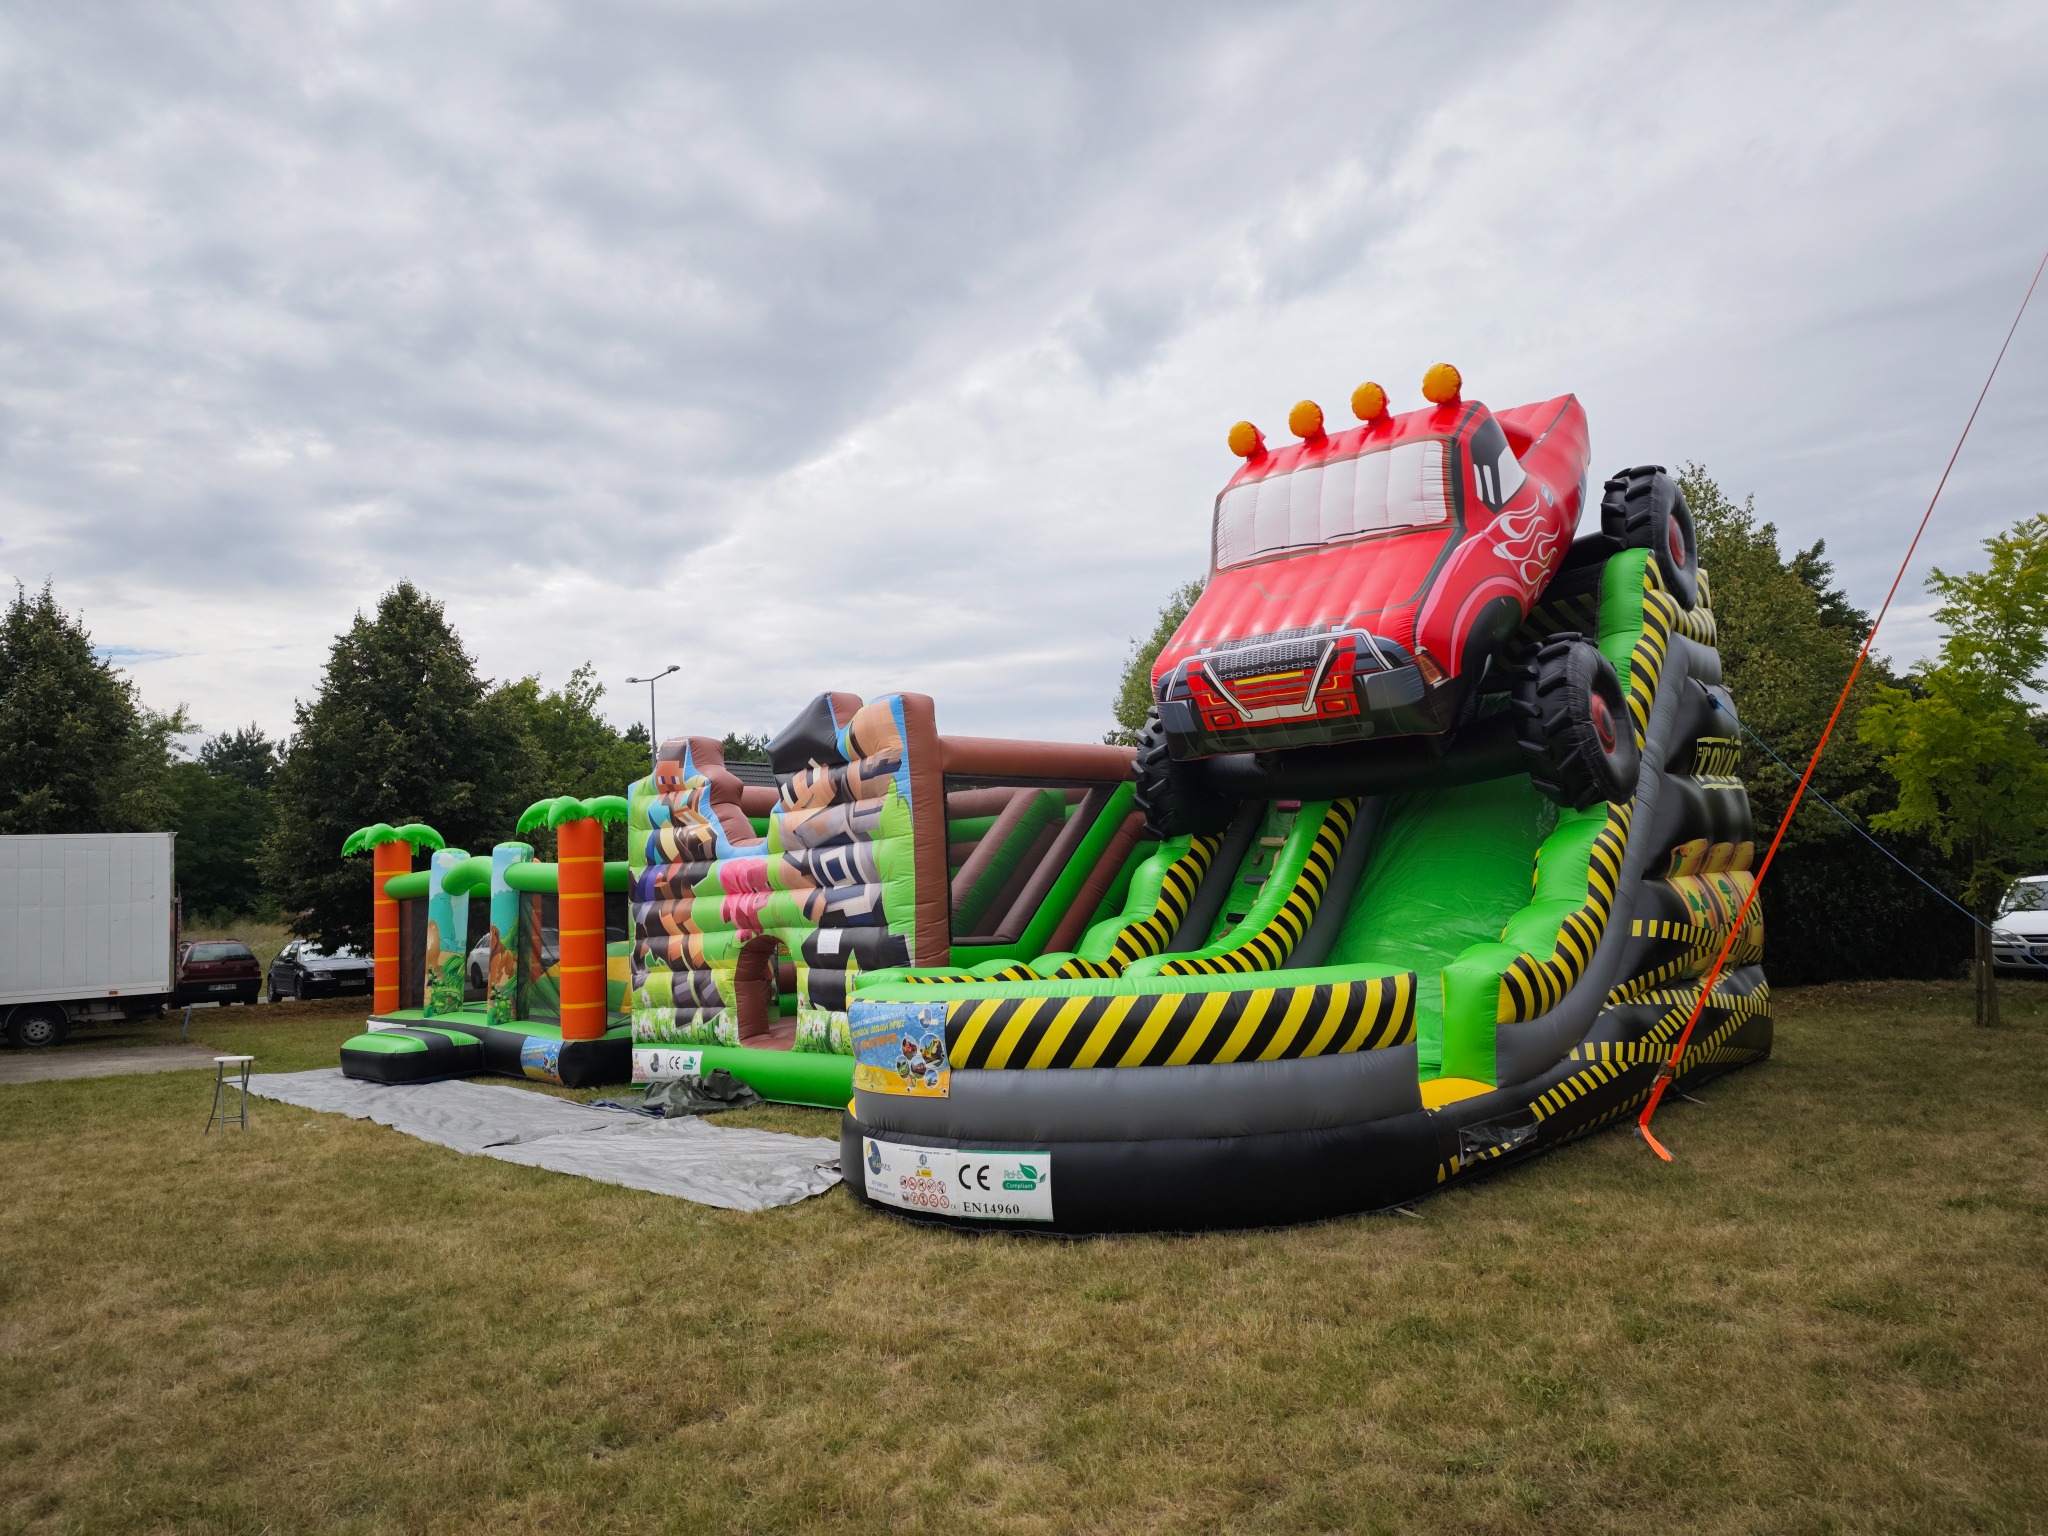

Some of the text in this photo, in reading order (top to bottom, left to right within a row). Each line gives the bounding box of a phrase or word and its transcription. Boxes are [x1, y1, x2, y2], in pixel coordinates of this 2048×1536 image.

[2035, 947, 2048, 955] OP
[958, 1164, 990, 1191] CE
[1004, 1170, 1023, 1179] RoHS
[963, 1202, 1020, 1214] EN14960
